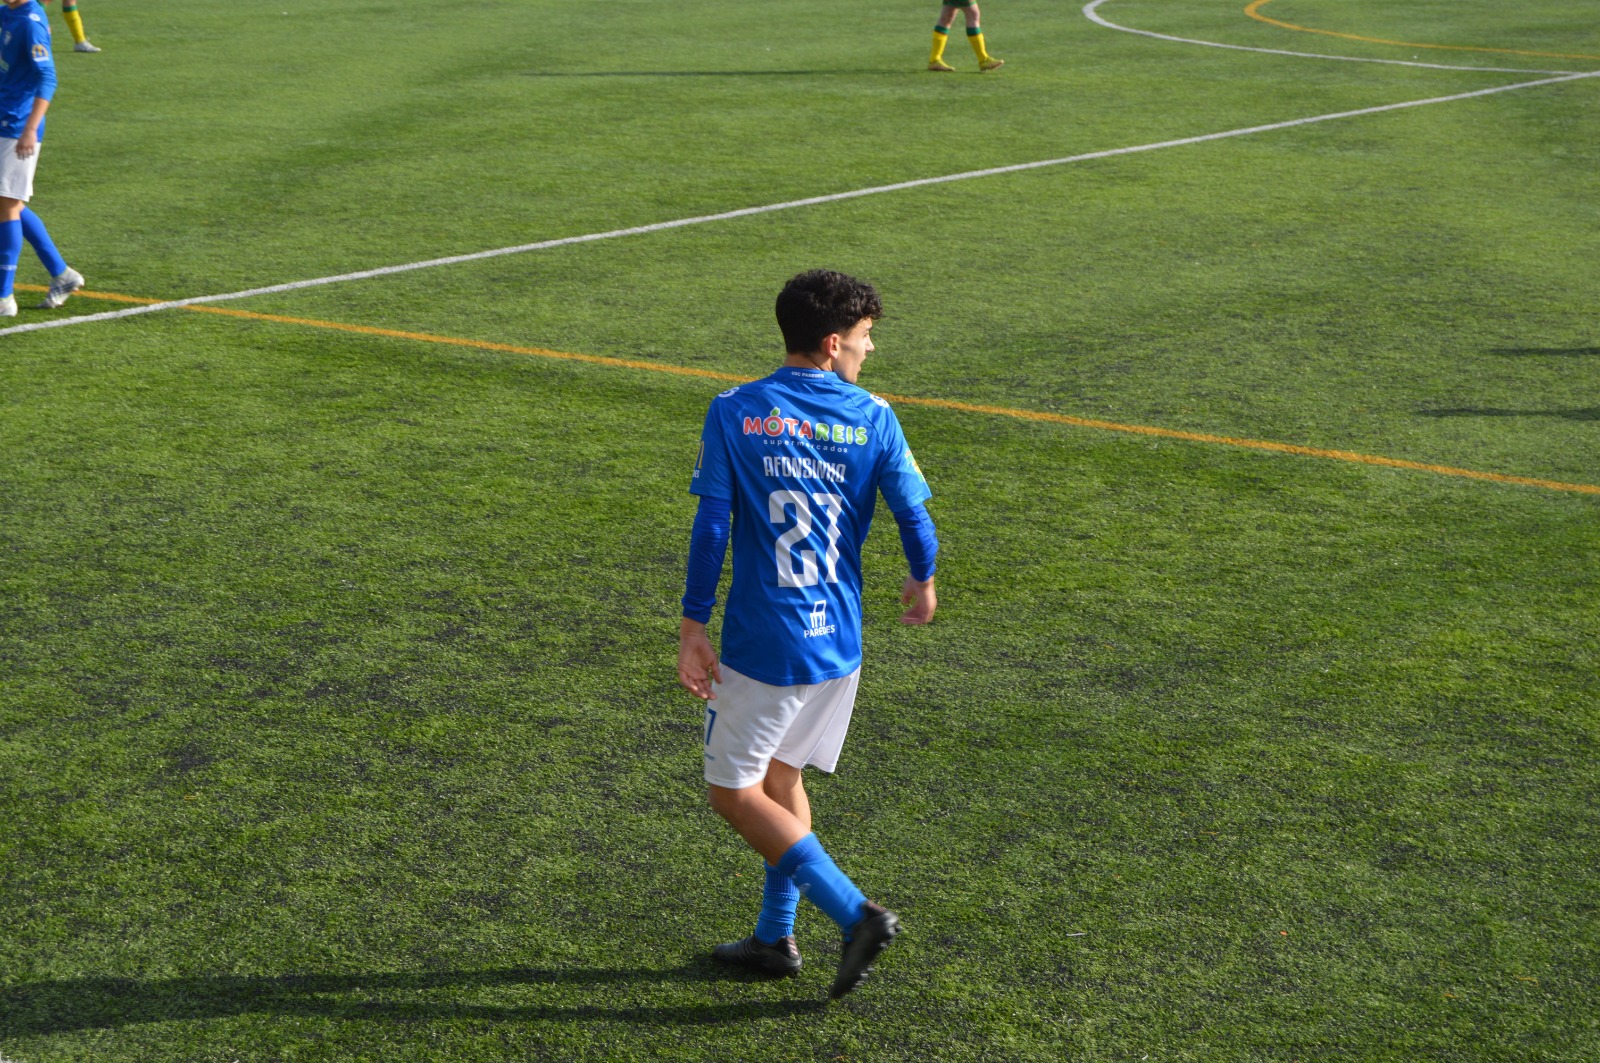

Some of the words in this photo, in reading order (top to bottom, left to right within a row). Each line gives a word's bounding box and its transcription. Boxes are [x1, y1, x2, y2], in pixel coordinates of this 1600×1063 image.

[763, 439, 848, 453] supermercados
[763, 456, 846, 484] AFONSINHO
[768, 489, 843, 588] 27
[803, 624, 836, 639] PAREDES
